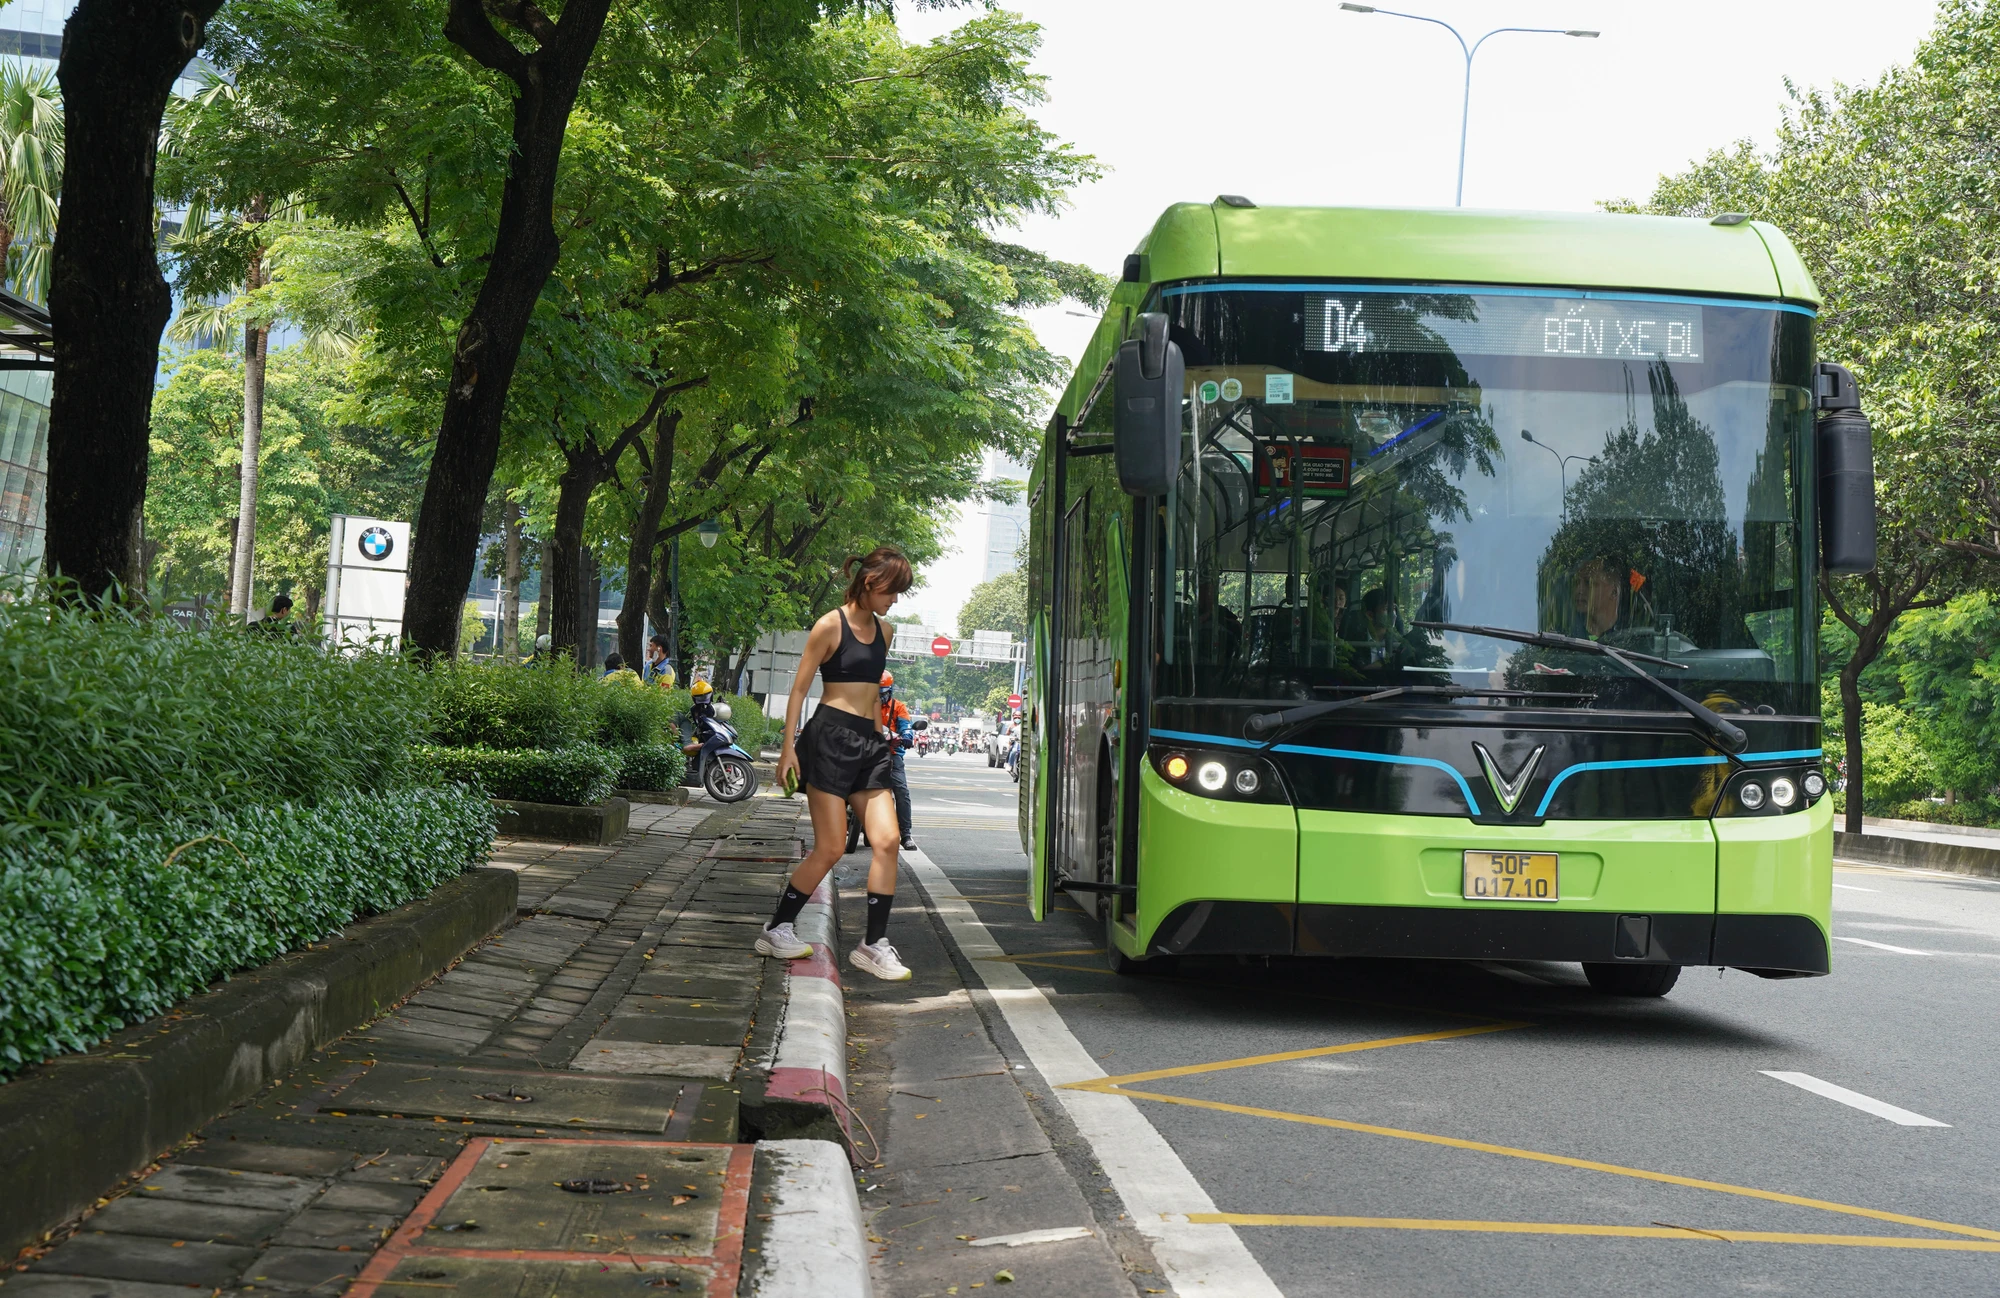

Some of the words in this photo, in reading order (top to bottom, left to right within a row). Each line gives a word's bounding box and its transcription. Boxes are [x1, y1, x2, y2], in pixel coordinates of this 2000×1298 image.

[1324, 300, 1366, 352] D4
[1544, 305, 1604, 354] BẾN
[1615, 320, 1656, 356] XE
[361, 527, 391, 540] BMW
[1491, 854, 1531, 875] 50F
[1475, 877, 1547, 898] 017.10
